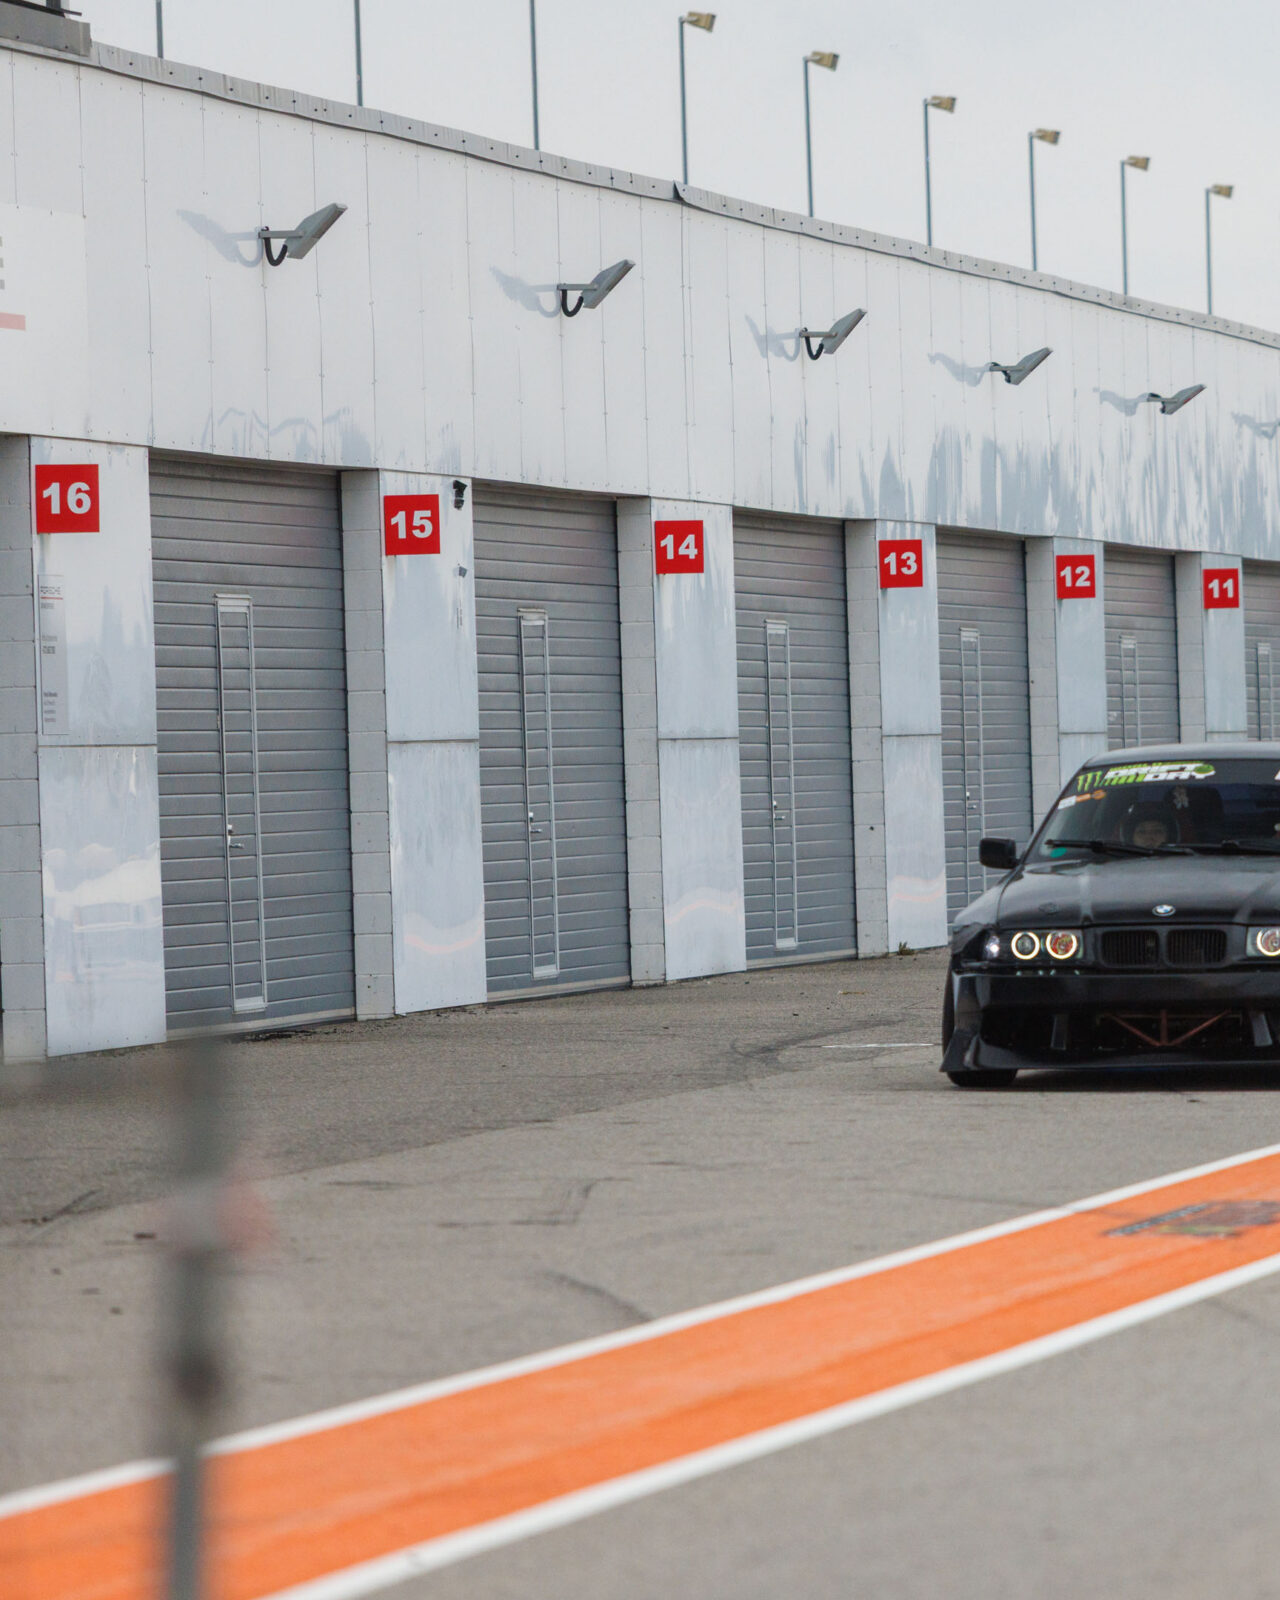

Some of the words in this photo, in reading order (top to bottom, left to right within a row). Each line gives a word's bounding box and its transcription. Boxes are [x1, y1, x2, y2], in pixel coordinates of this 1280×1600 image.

[42, 481, 92, 515] 16
[390, 509, 433, 540] 15
[660, 533, 699, 560] 14
[883, 551, 918, 576] 13
[1060, 565, 1091, 588] 12
[1208, 578, 1234, 599] 11
